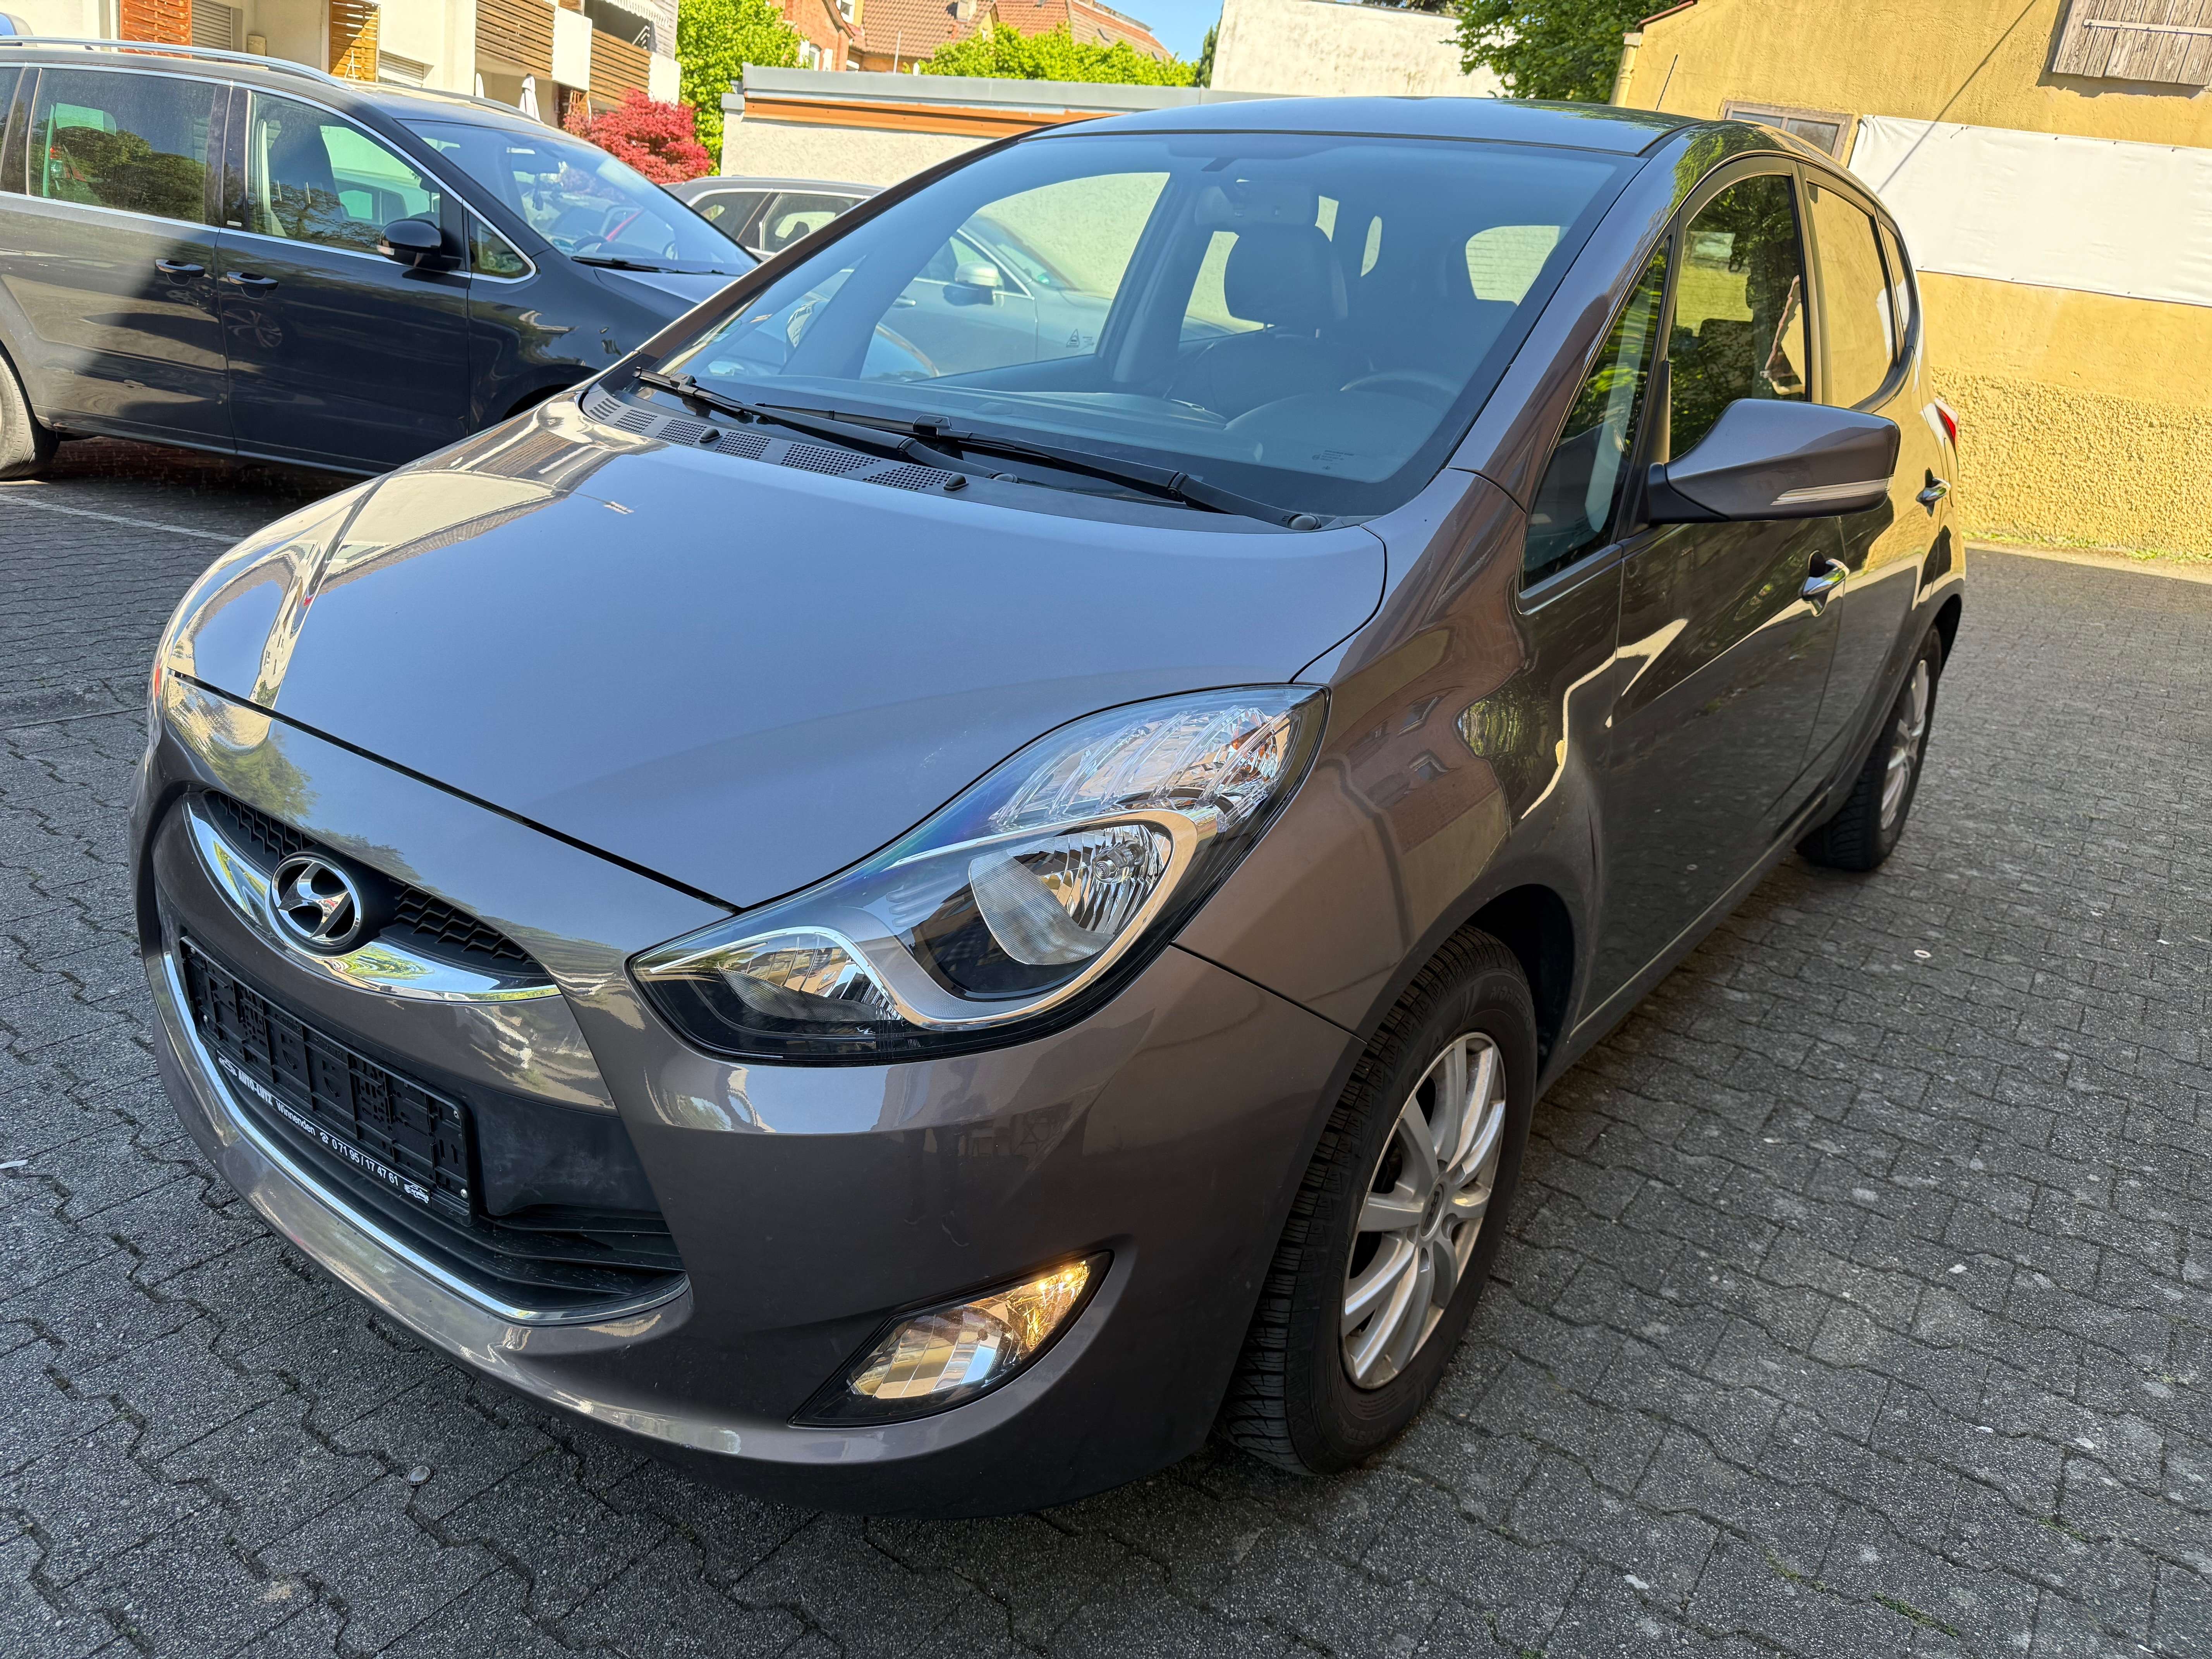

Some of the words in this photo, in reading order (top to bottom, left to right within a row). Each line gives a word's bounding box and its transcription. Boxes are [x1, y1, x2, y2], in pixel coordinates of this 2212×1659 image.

[239, 1070, 273, 1106] AUTO-LUTZ
[276, 1100, 316, 1136] Winnenden
[377, 1166, 386, 1178] 47
[388, 1173, 398, 1186] 61
